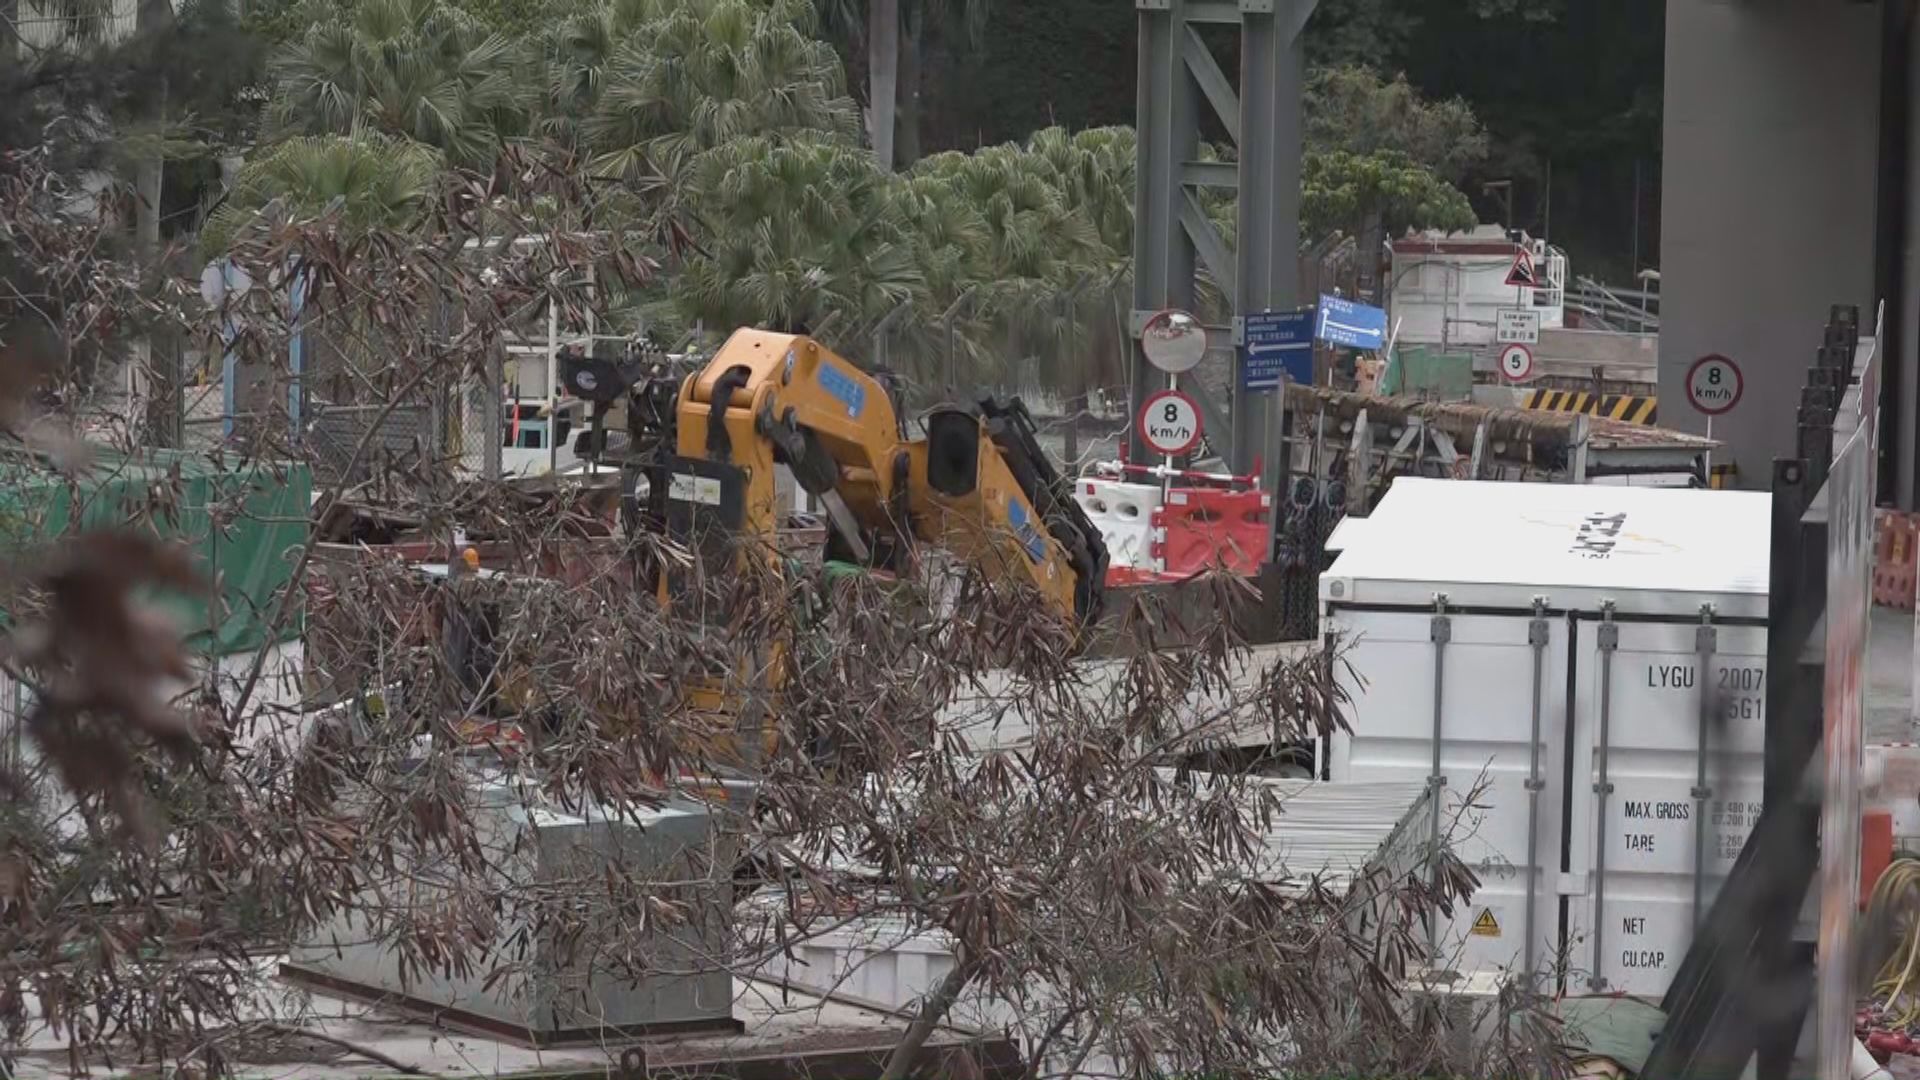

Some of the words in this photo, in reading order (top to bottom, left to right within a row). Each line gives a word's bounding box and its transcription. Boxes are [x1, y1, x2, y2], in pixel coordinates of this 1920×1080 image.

[1512, 354, 1521, 369] 5
[1709, 367, 1721, 385] 8
[1695, 386, 1732, 399] km/h
[1164, 403, 1178, 423] 8
[1150, 425, 1190, 439] km/h
[1648, 665, 1694, 688] LYGU
[1719, 668, 1763, 691] 2007
[1656, 802, 1689, 819] GROSS
[1624, 834, 1655, 852] TARE
[1623, 918, 1646, 935] NET
